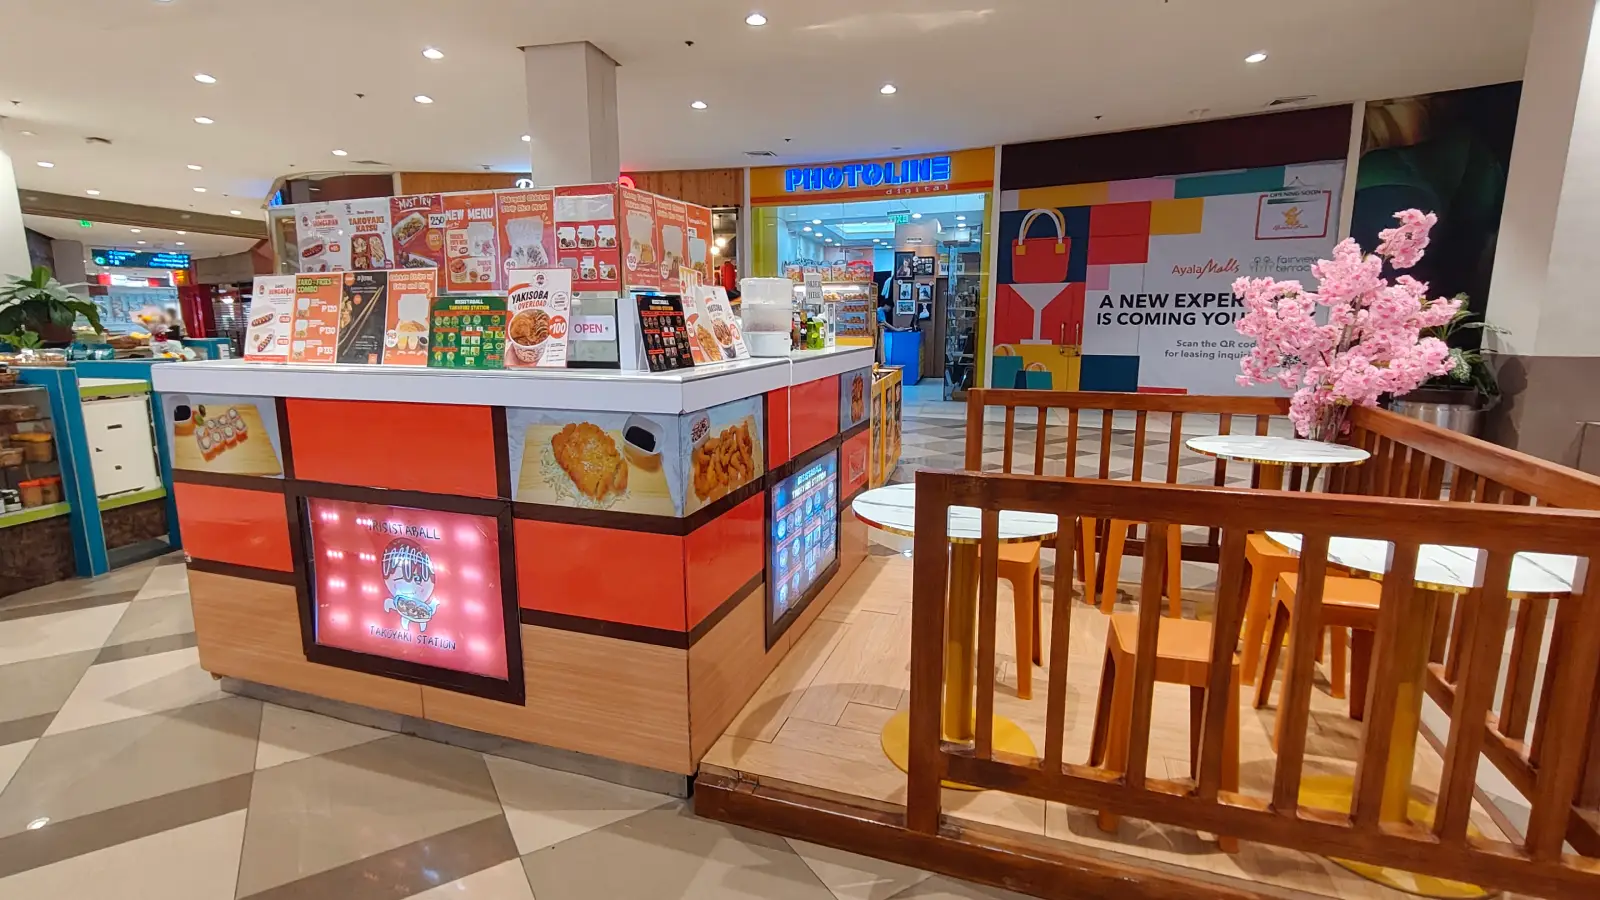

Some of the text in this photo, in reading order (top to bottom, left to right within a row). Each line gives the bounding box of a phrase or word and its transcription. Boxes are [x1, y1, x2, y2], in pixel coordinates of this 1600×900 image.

[785, 156, 951, 192] PHOTOLINE
[886, 184, 949, 196] digital
[445, 207, 494, 220] NEW MENU
[349, 216, 385, 225] TAKOYAKI
[356, 224, 378, 232] KATSU
[1172, 258, 1240, 279] Ayala Malls
[1276, 264, 1312, 273] terrac
[511, 290, 549, 304] YAKISOBA
[1099, 293, 1245, 308] A NEW EXPER
[517, 300, 547, 310] OVERLOAD
[1097, 312, 1246, 326] IS COMING YOU
[574, 324, 603, 334] OPEN
[1176, 340, 1199, 348] Scan
[1201, 340, 1217, 348] the
[1238, 340, 1257, 348] cod
[1165, 350, 1179, 358] for
[1181, 350, 1215, 360] leasing
[370, 625, 456, 650] TAKOYAKI STATION
